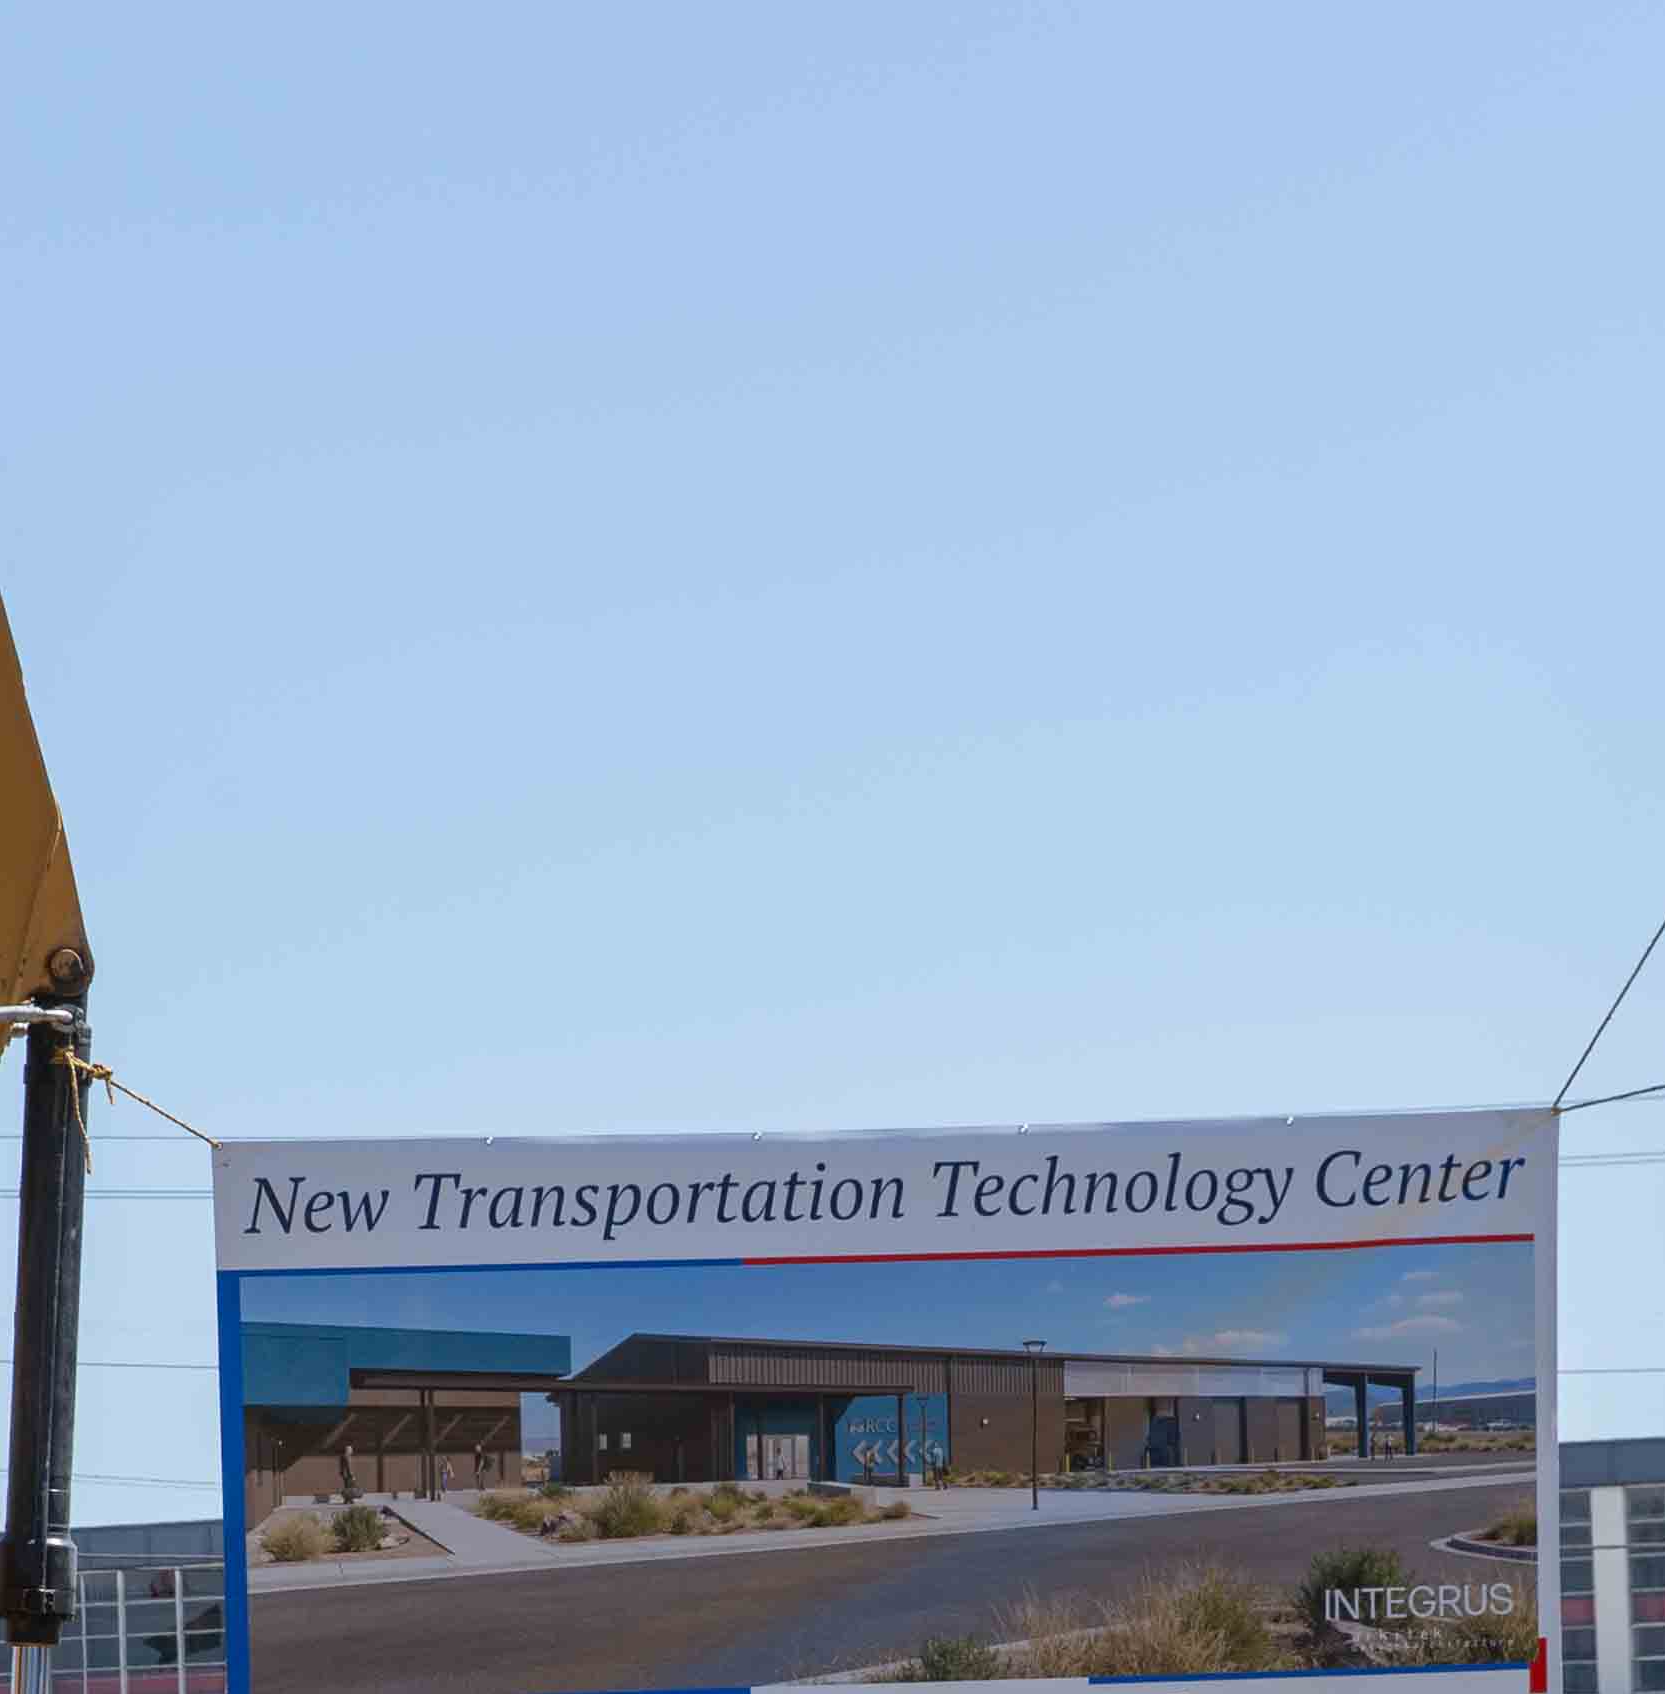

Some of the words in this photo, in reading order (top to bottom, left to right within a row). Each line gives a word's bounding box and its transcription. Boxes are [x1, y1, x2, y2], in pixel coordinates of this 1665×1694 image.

[244, 1176, 390, 1235] New
[414, 1162, 906, 1241] Transportation
[933, 1152, 1295, 1226] Technology
[1315, 1149, 1526, 1208] Center
[1324, 1583, 1515, 1621] INTEGRUS
